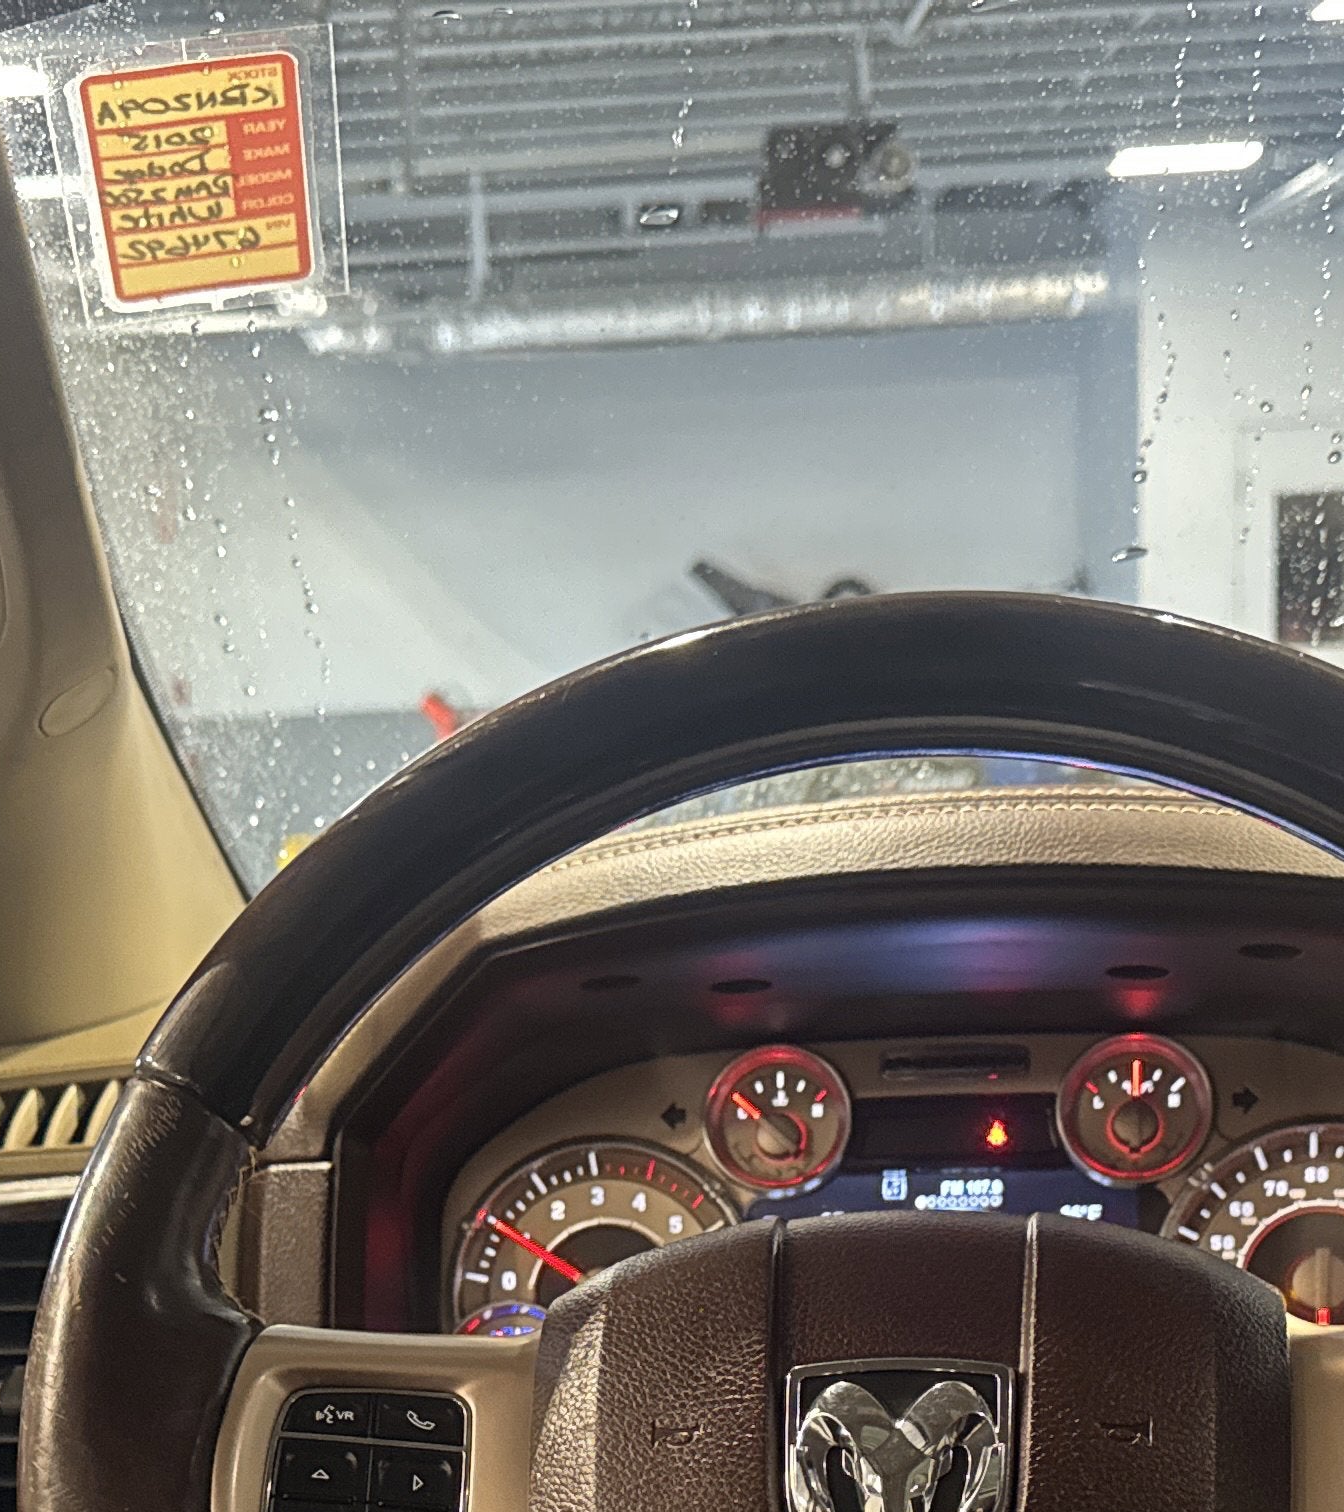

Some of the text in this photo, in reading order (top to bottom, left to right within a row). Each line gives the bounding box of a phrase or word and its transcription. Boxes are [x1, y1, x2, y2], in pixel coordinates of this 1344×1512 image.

[590, 1186, 605, 1206] 3
[632, 1193, 647, 1212] 4
[550, 1201, 566, 1221] 2
[668, 1214, 684, 1234] 5
[501, 1270, 518, 1291] 0
[336, 1410, 354, 1421] VR
